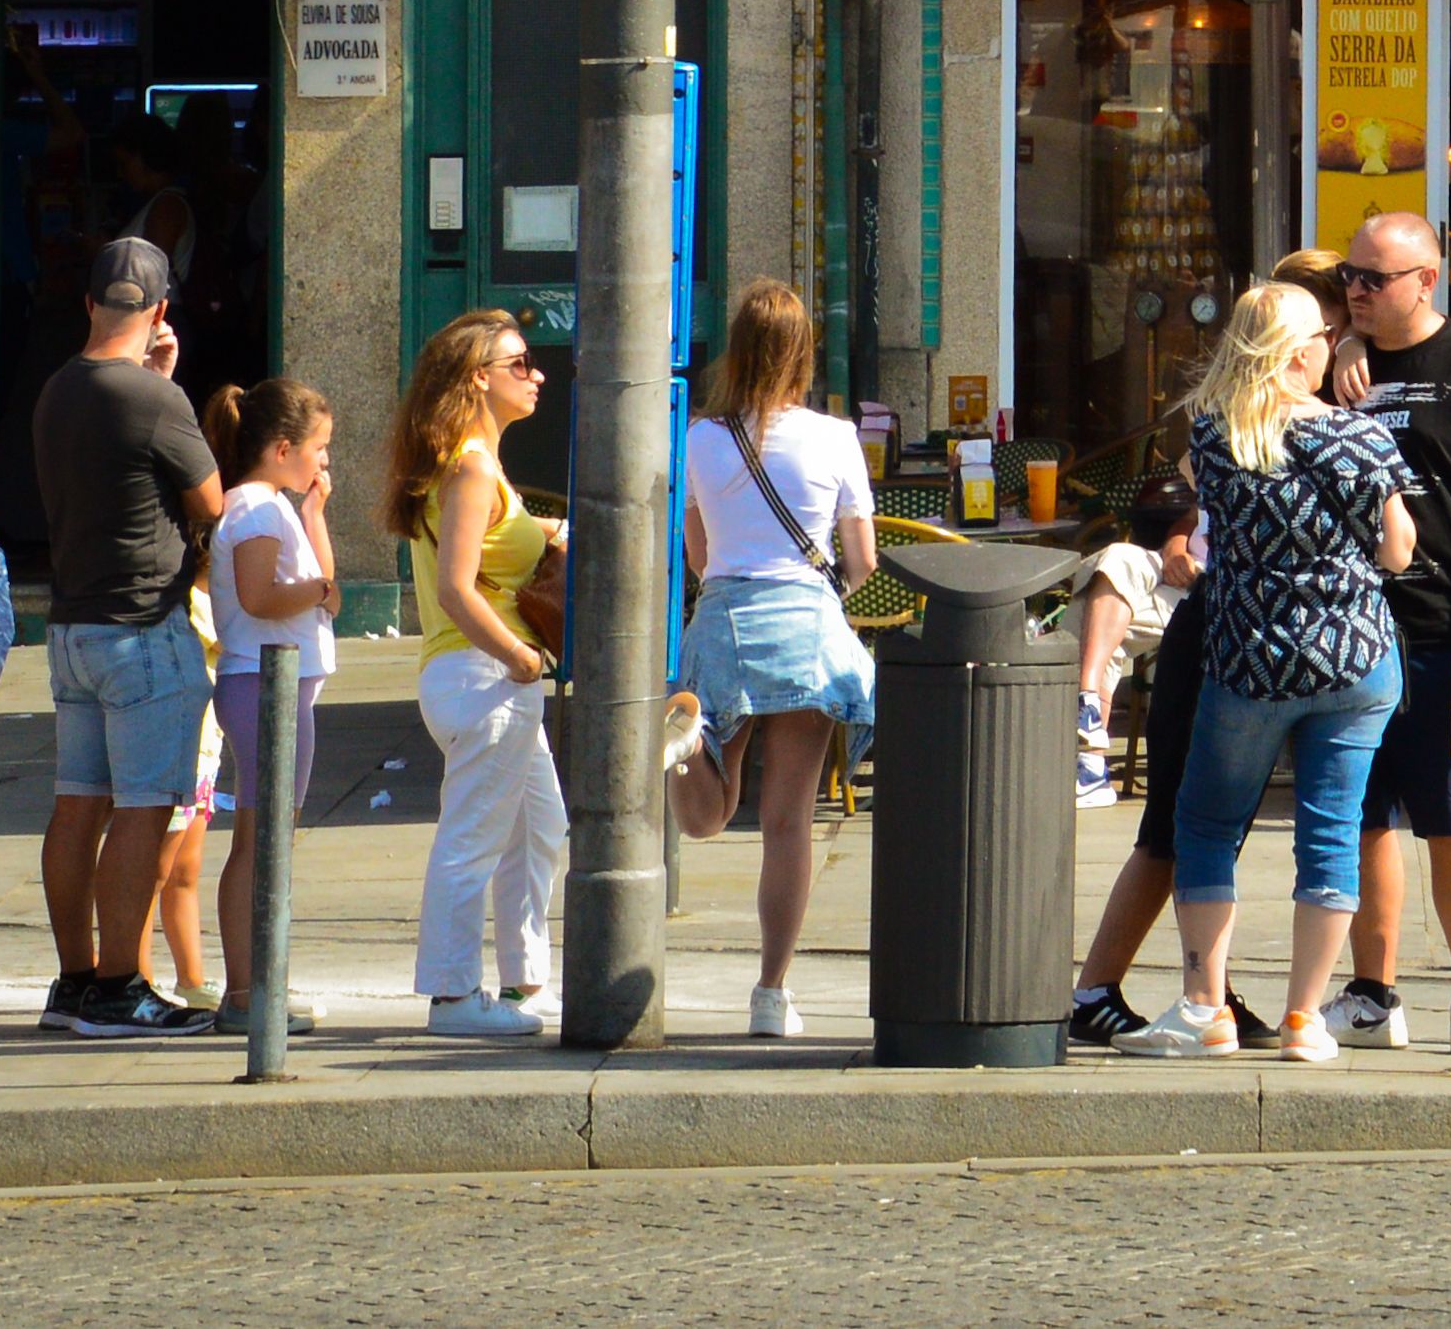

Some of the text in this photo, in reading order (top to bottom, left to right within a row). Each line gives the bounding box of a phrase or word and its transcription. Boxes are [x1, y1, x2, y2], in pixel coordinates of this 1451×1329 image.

[302, 3, 381, 25] ELVIRA DE SOUSA
[1330, 9, 1417, 33] COM QUEIJO
[303, 39, 380, 60] ADVOGADA
[1330, 35, 1417, 63] SERRA DA
[1329, 66, 1417, 88] ESTRELA DOP
